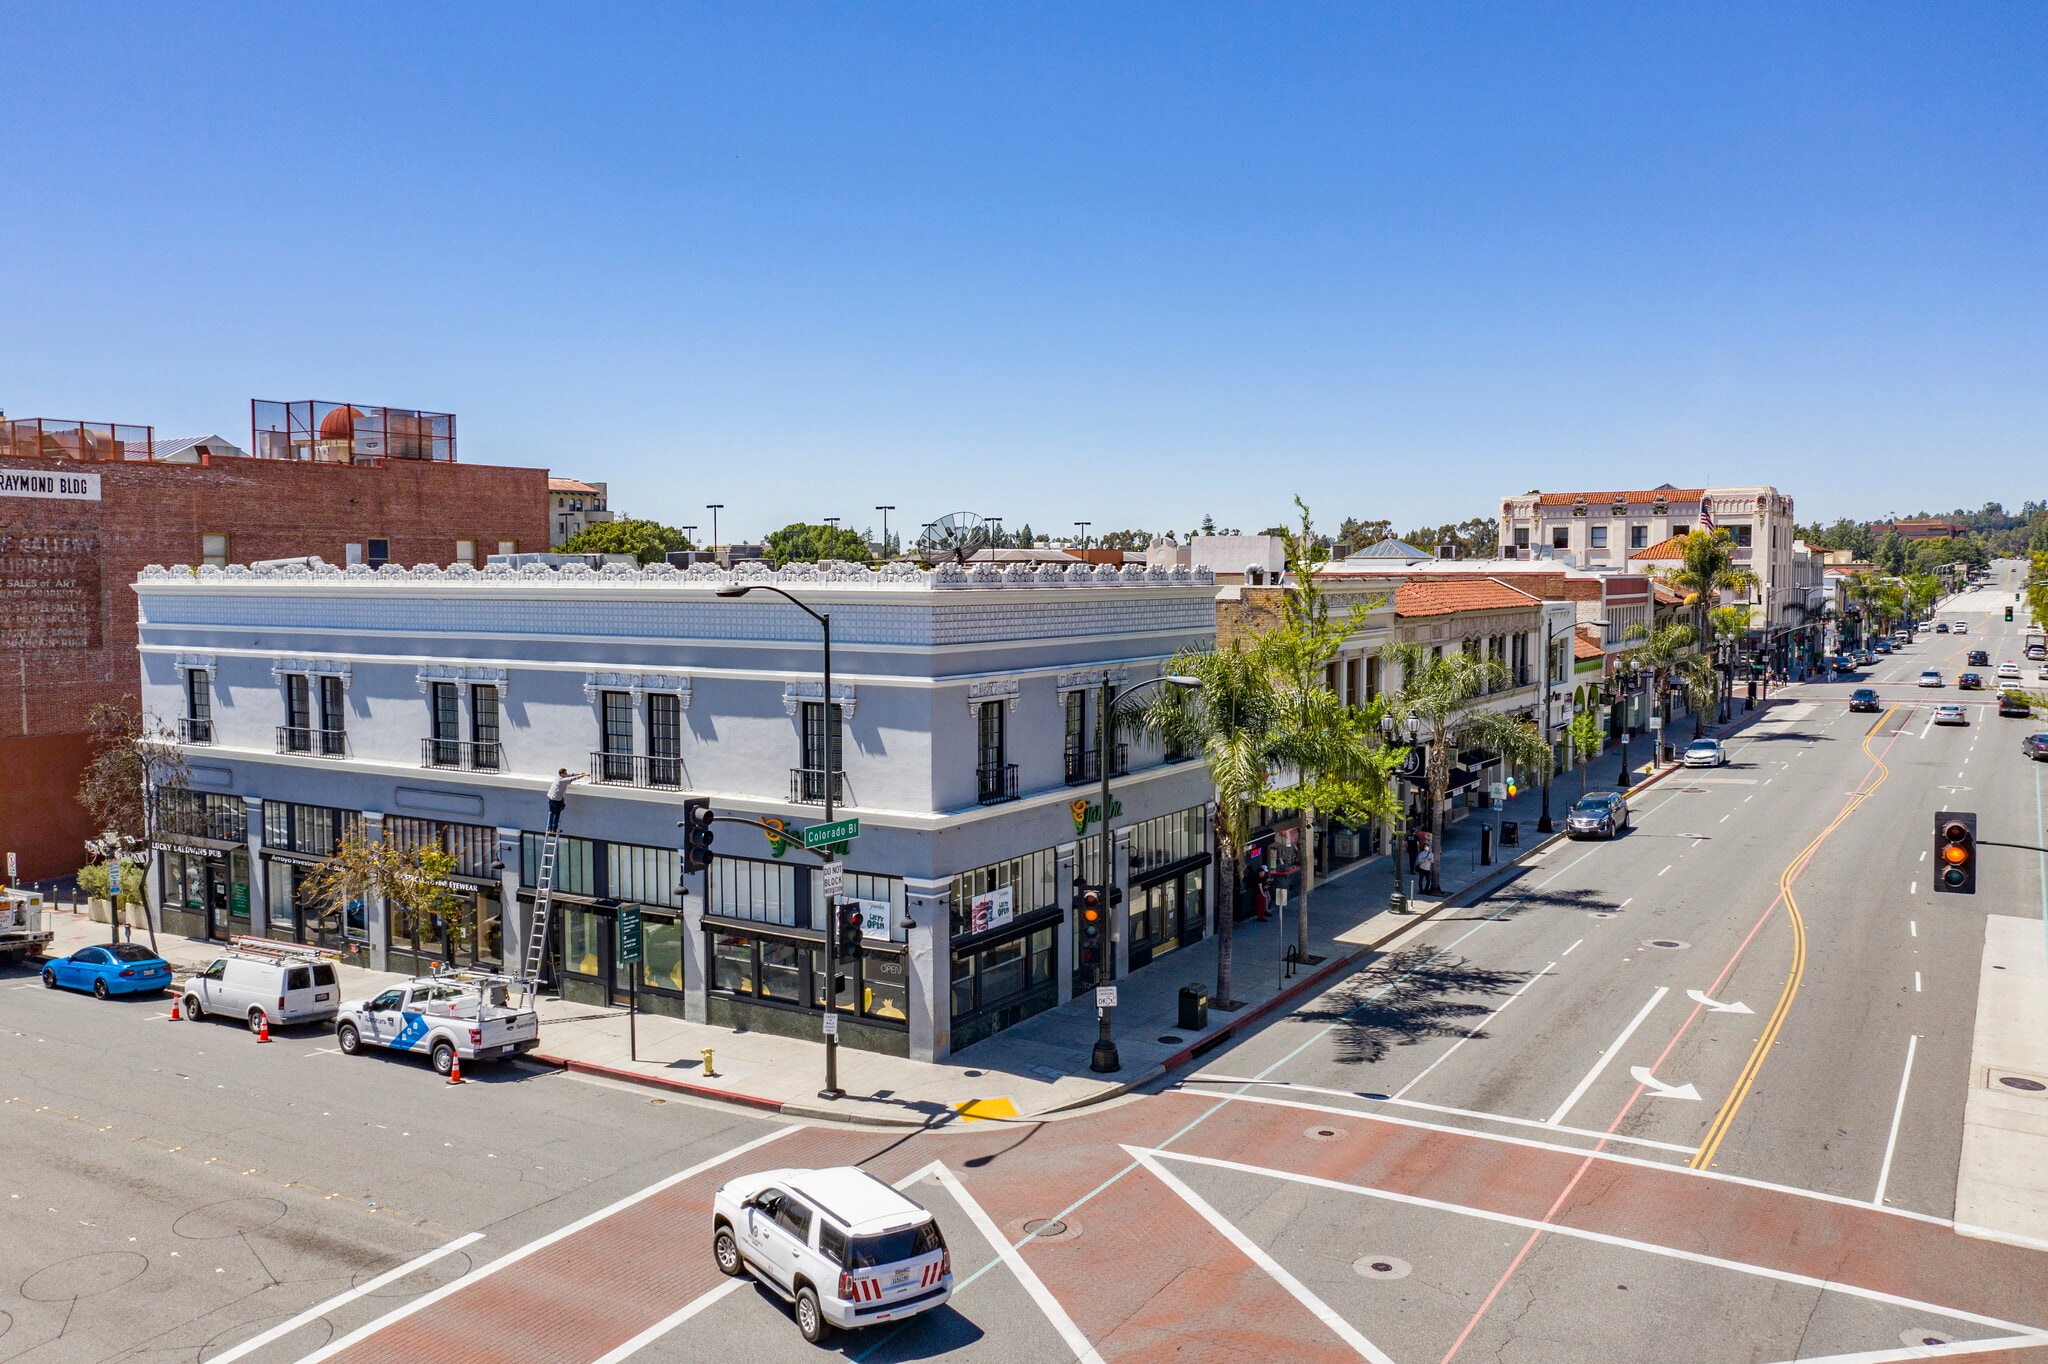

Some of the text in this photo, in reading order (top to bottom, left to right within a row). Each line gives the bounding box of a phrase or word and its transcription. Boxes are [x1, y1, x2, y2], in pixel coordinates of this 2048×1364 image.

[60, 478, 87, 494] BLDG
[6, 579, 77, 588] SALES of ART
[808, 826, 846, 843] Colorado
[152, 842, 172, 852] LUCKY
[208, 850, 222, 858] PUB
[271, 854, 291, 864] Arroyo
[824, 865, 843, 876] DO NOT
[449, 881, 478, 892] EYEWEAR
[824, 877, 843, 887] BLOCK
[881, 963, 903, 975] OPEN
[516, 1022, 535, 1030] Spectrum
[895, 1267, 910, 1275] GMC
